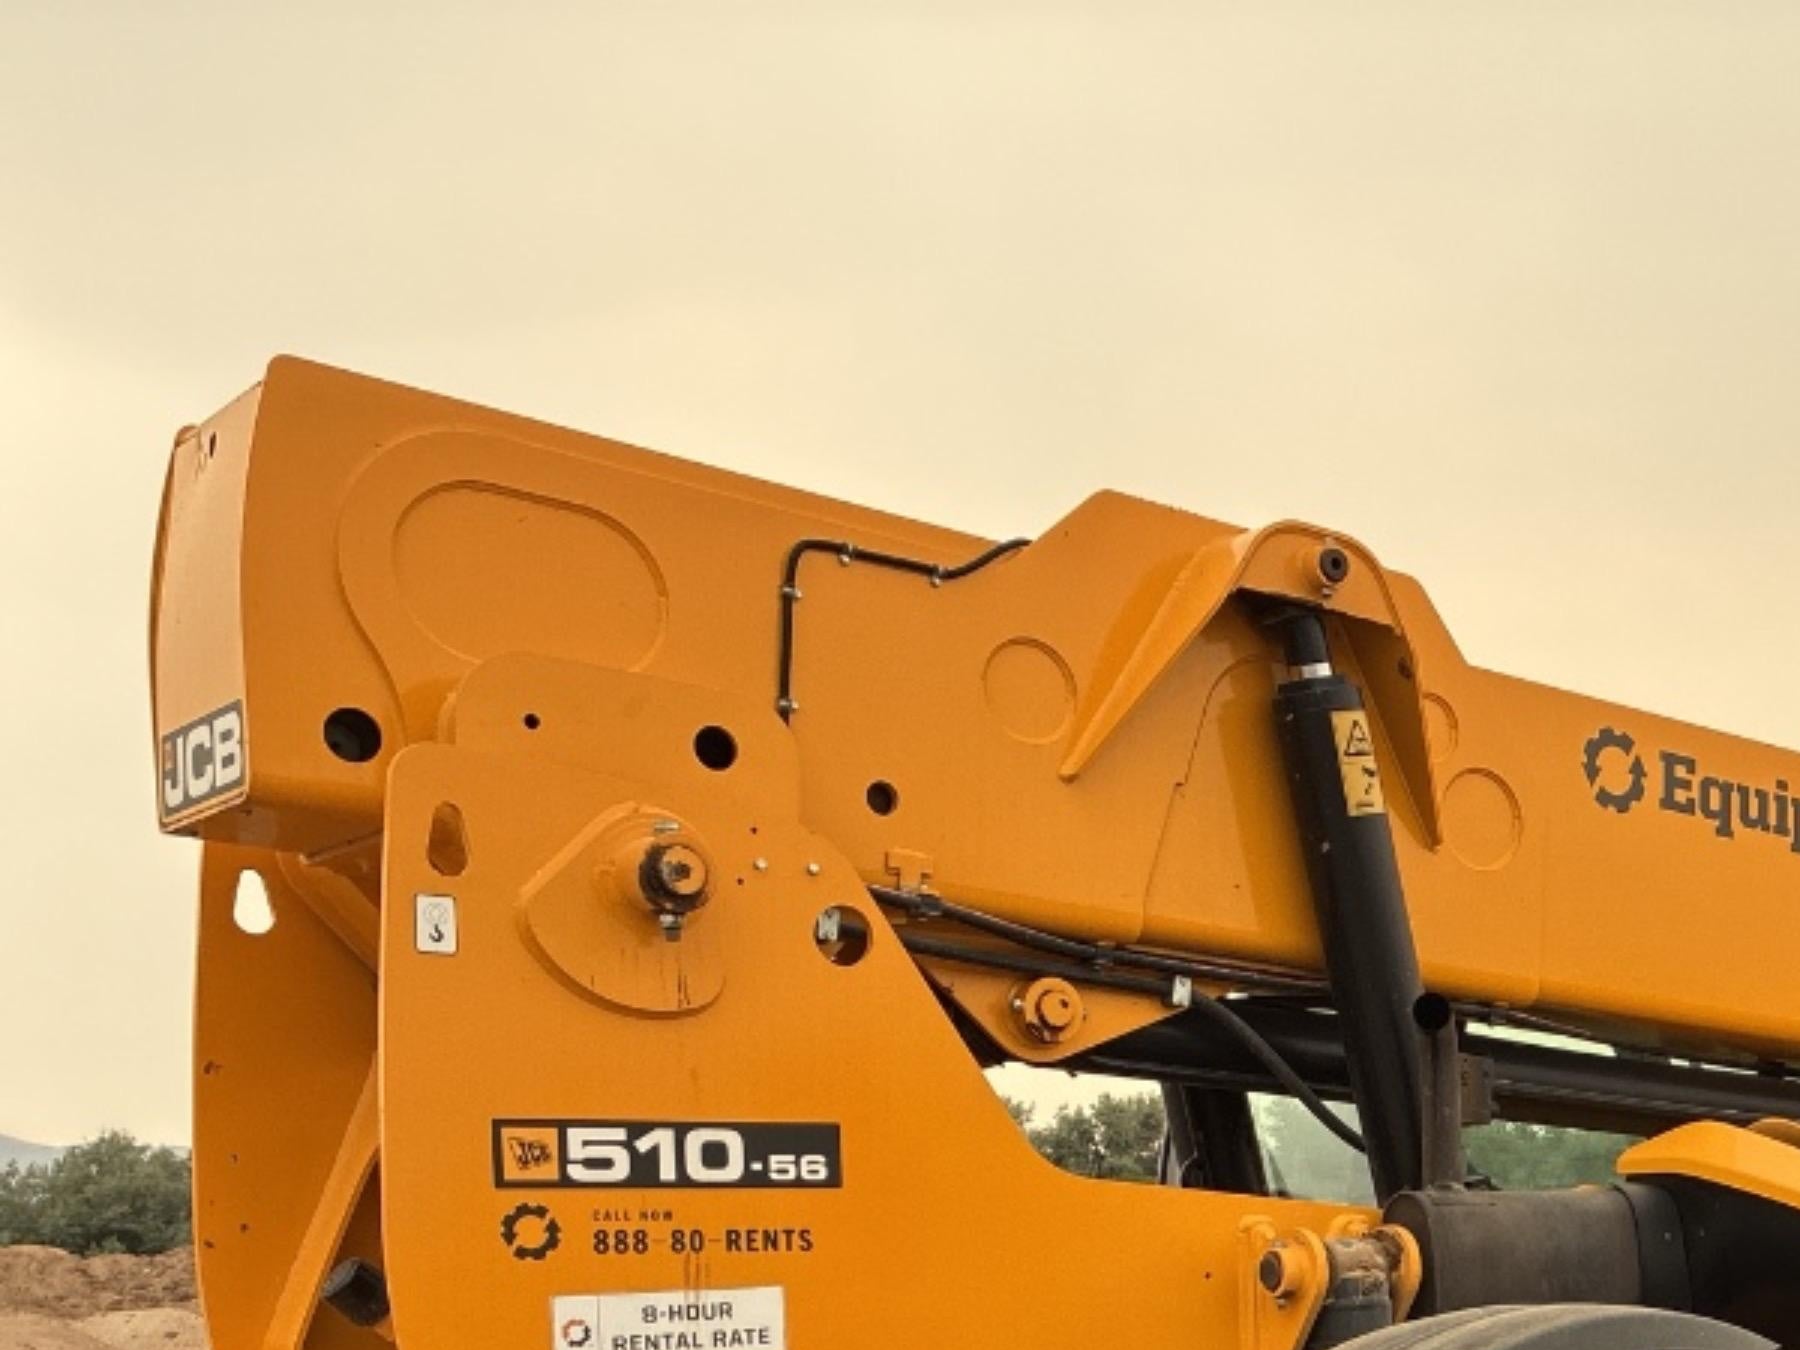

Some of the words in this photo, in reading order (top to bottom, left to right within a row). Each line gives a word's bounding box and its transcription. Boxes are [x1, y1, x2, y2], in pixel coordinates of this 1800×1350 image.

[164, 710, 242, 808] JCB
[593, 1209, 631, 1222] CALL
[639, 1209, 673, 1222] NOW
[641, 1301, 734, 1324] 8-HOUR
[713, 1326, 772, 1348] RATE
